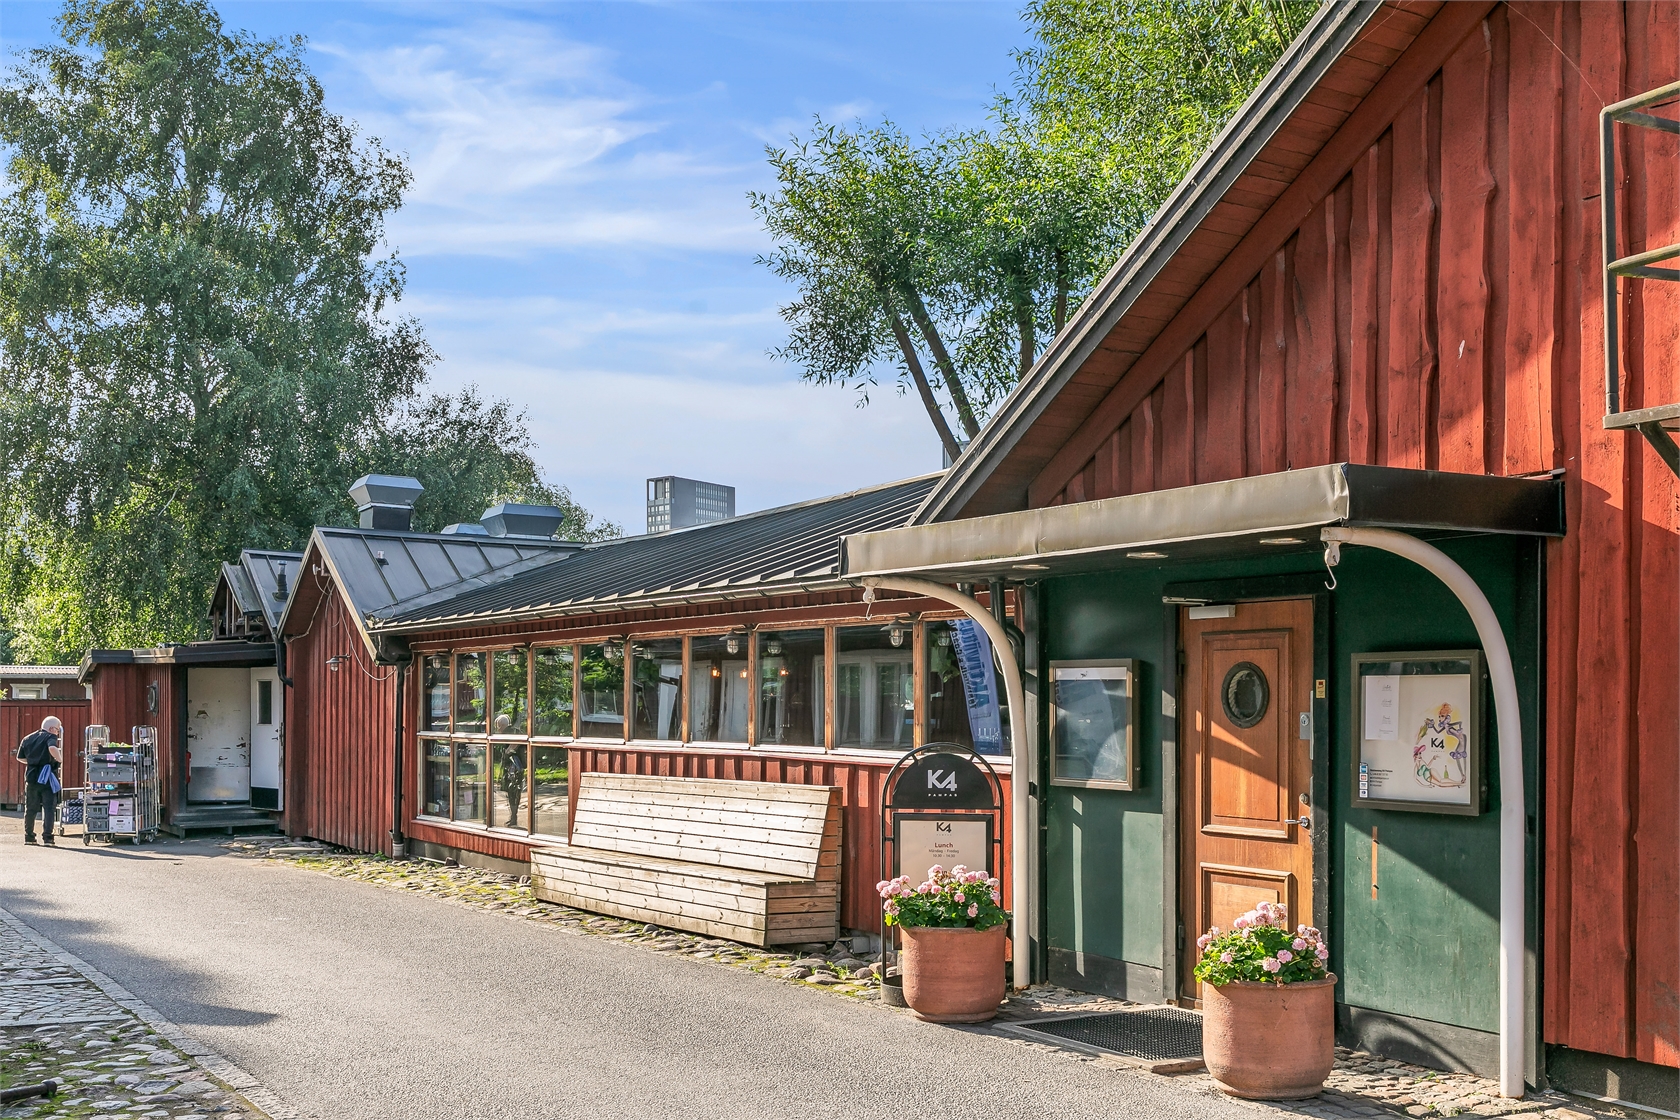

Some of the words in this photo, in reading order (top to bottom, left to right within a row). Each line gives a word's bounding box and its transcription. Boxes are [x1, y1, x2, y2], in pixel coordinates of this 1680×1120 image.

[1431, 737, 1445, 749] K4
[927, 769, 958, 792] K4
[936, 822, 952, 833] K4
